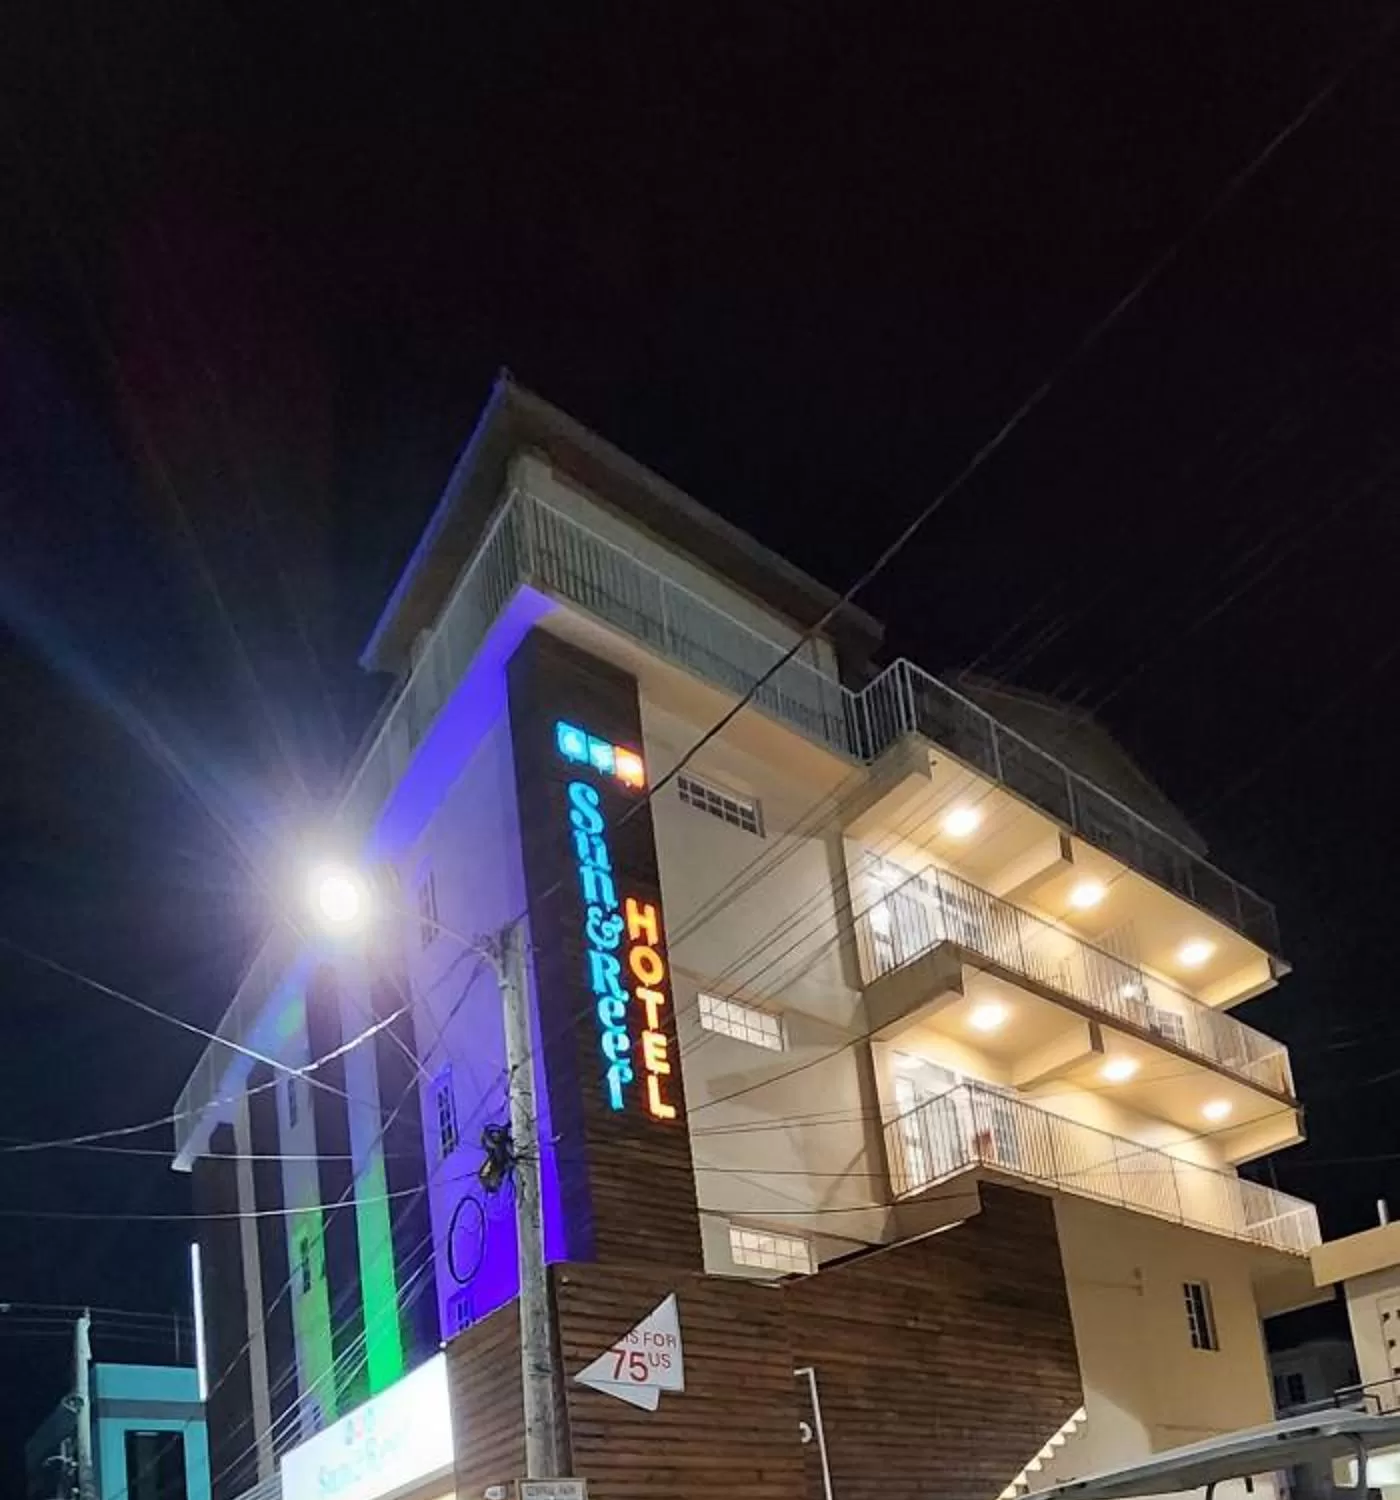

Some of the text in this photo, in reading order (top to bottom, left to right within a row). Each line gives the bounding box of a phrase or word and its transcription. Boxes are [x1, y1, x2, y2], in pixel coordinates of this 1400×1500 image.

[624, 896, 676, 1119] HOTEL
[643, 1330, 677, 1349] FOR
[611, 1348, 671, 1382] 75 US
